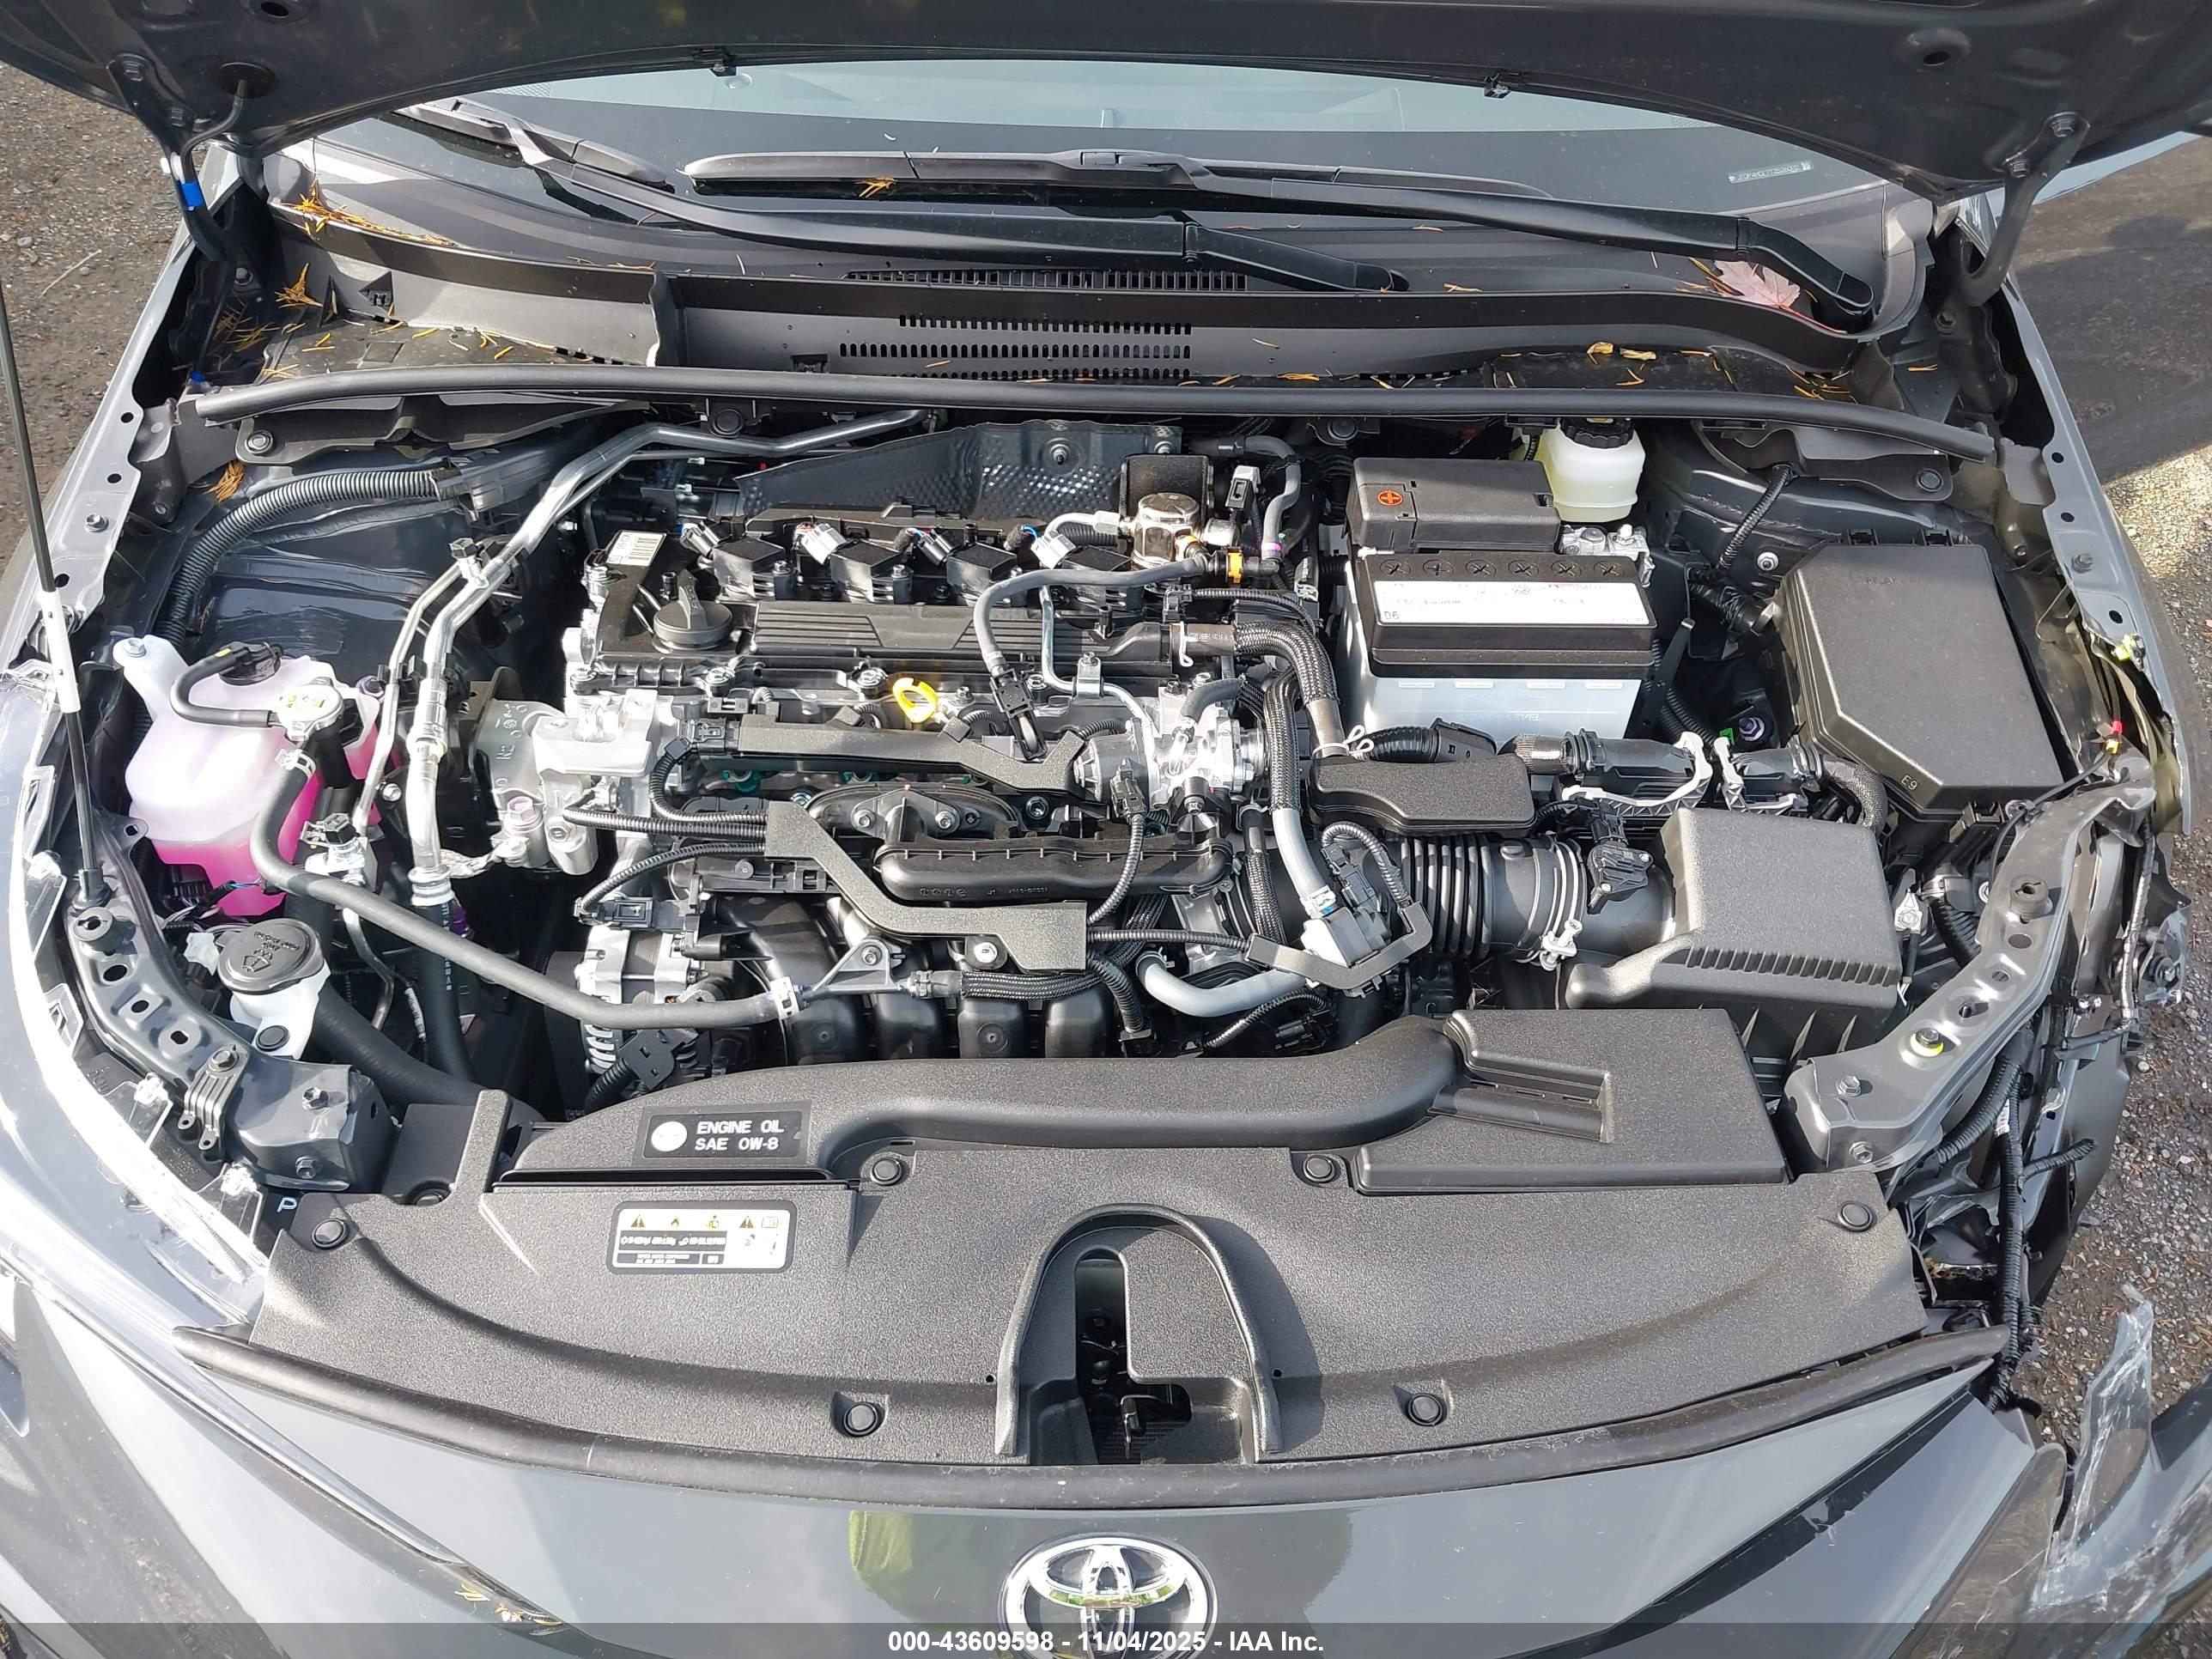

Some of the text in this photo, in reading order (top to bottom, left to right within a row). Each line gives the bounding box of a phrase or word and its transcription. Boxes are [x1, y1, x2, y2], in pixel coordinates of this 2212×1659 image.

[1901, 775, 1917, 790] E9
[696, 1120, 785, 1134] ENGINE OIL
[694, 1136, 779, 1151] SAE 0W-8
